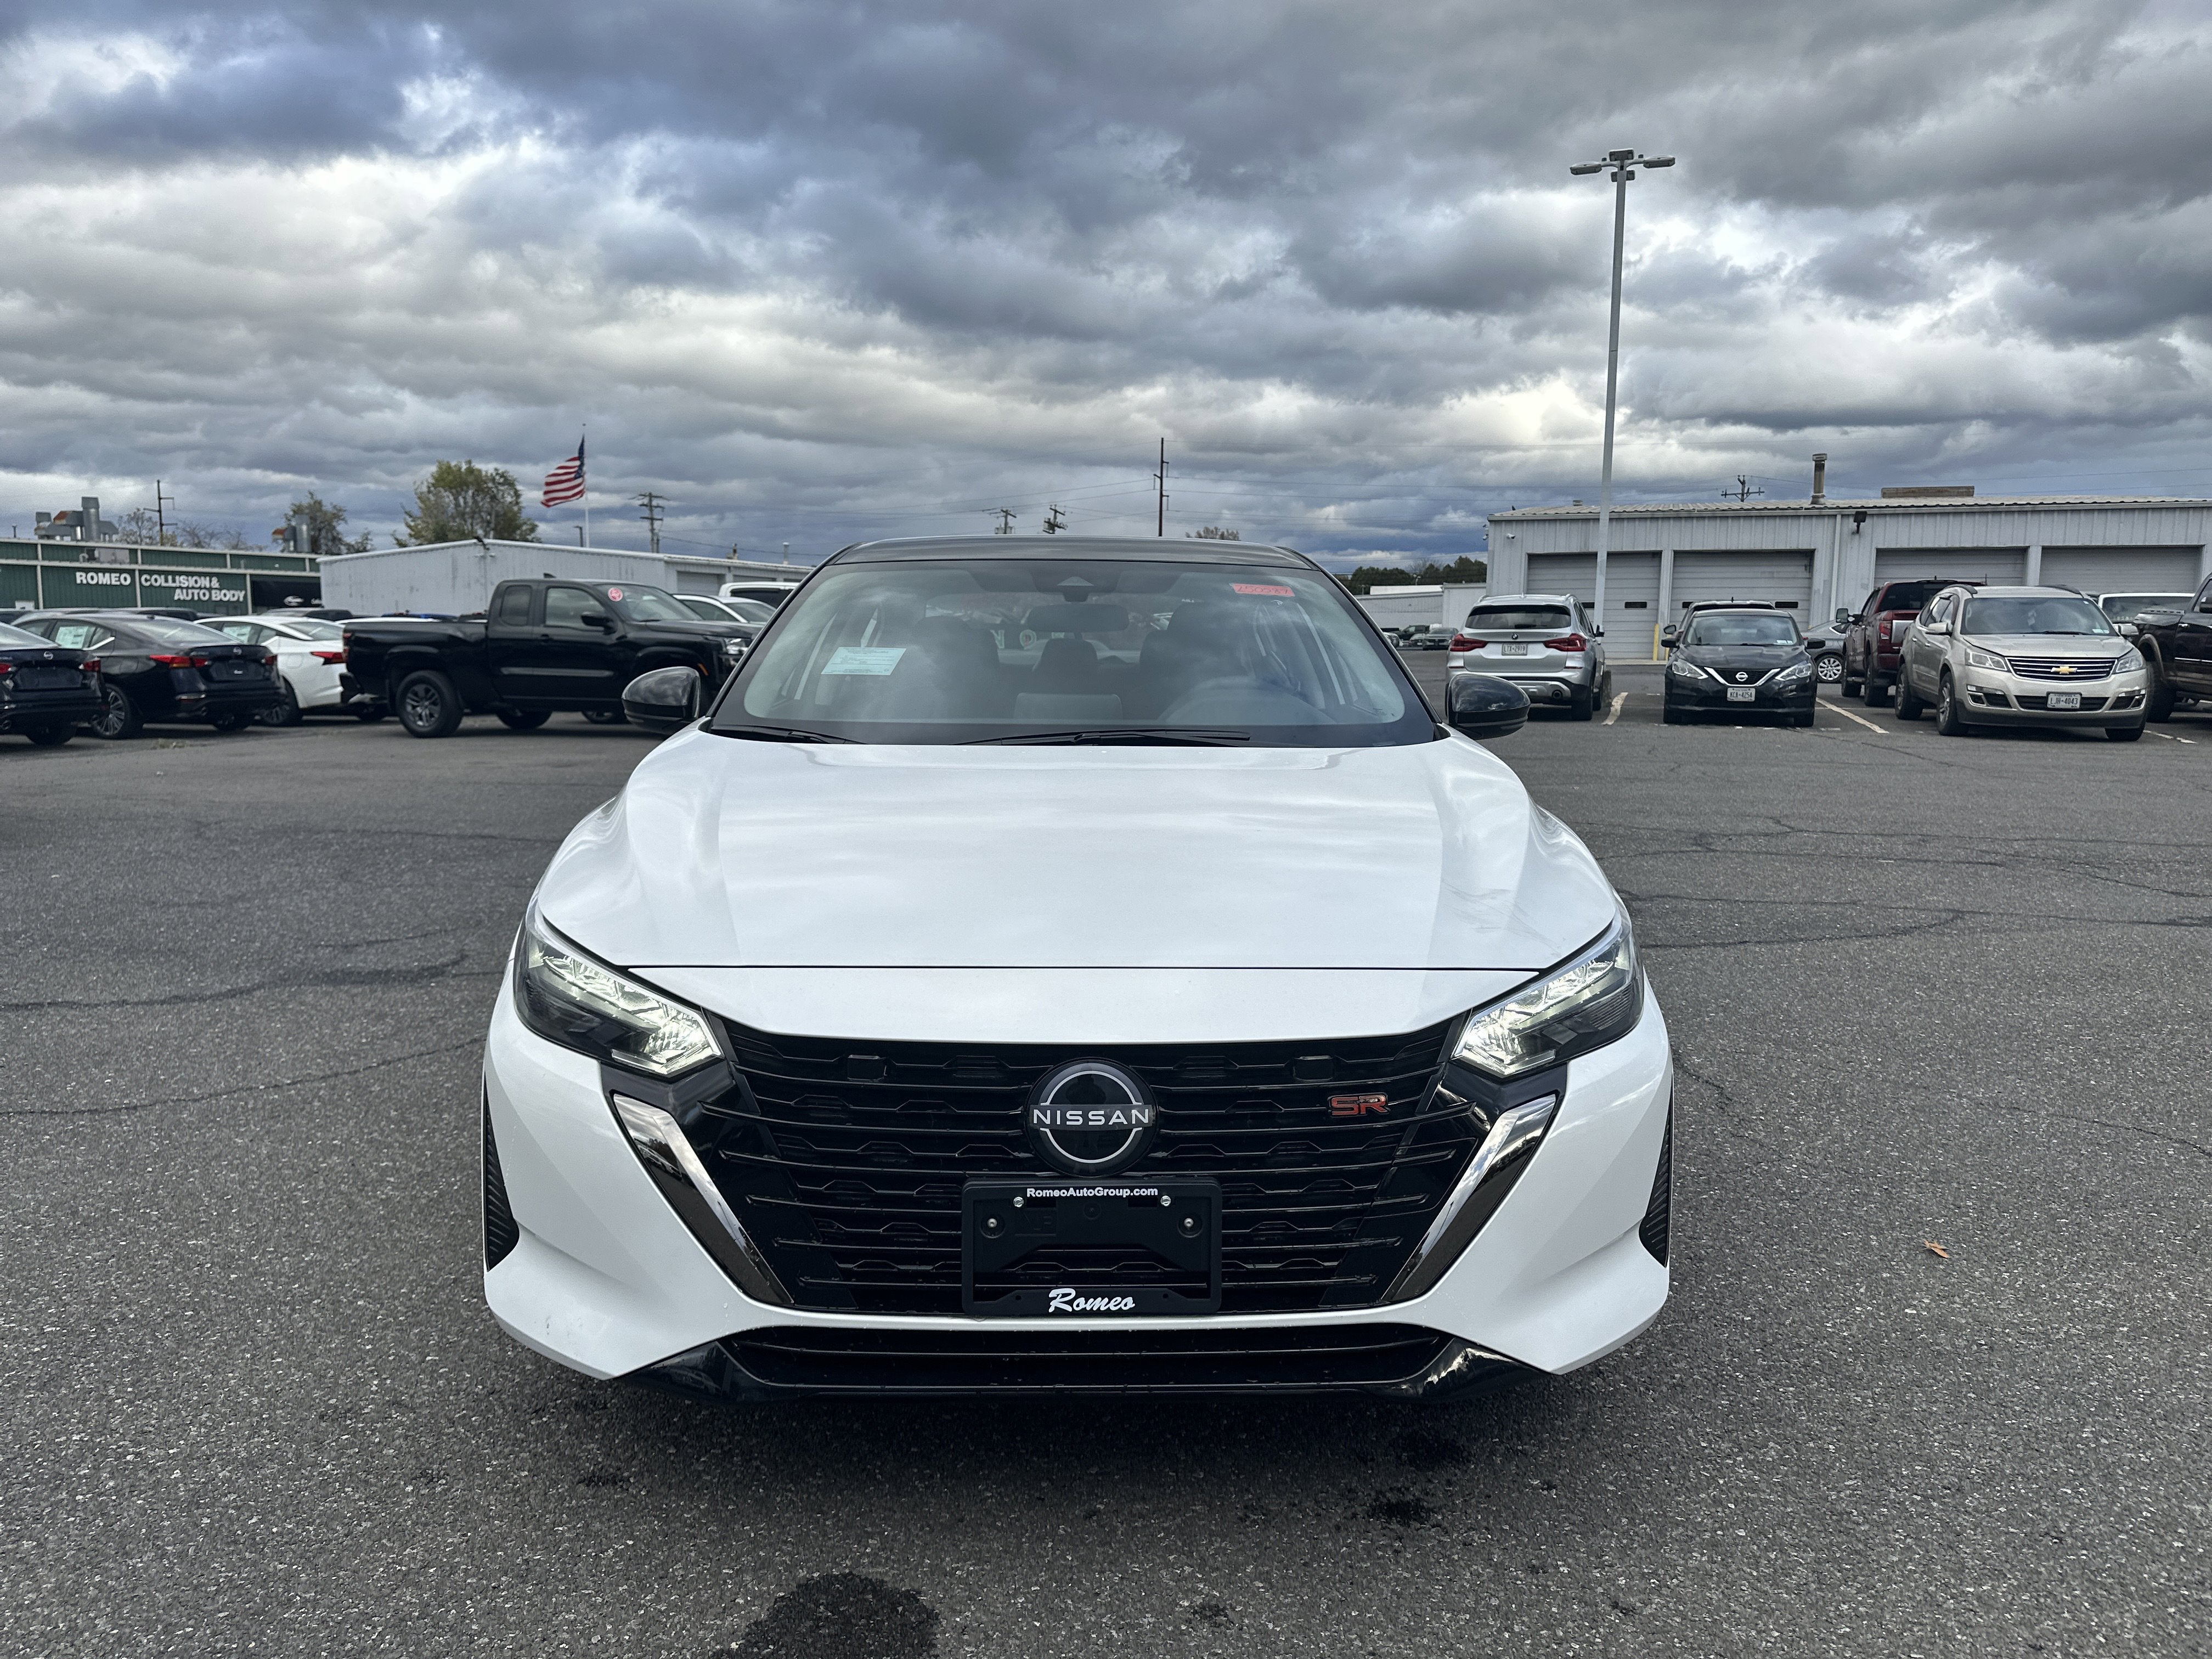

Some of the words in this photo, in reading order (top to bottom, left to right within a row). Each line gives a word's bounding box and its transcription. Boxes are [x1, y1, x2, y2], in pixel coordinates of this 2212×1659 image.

[76, 572, 131, 585] ROMEO
[174, 588, 210, 600] AUTO
[211, 589, 245, 601] BODY
[1331, 1094, 1388, 1115] SR
[1034, 1109, 1148, 1125] NISSAN
[1026, 1187, 1158, 1198] RomeoAutoGroup.com
[1048, 1288, 1135, 1312] Romeo
